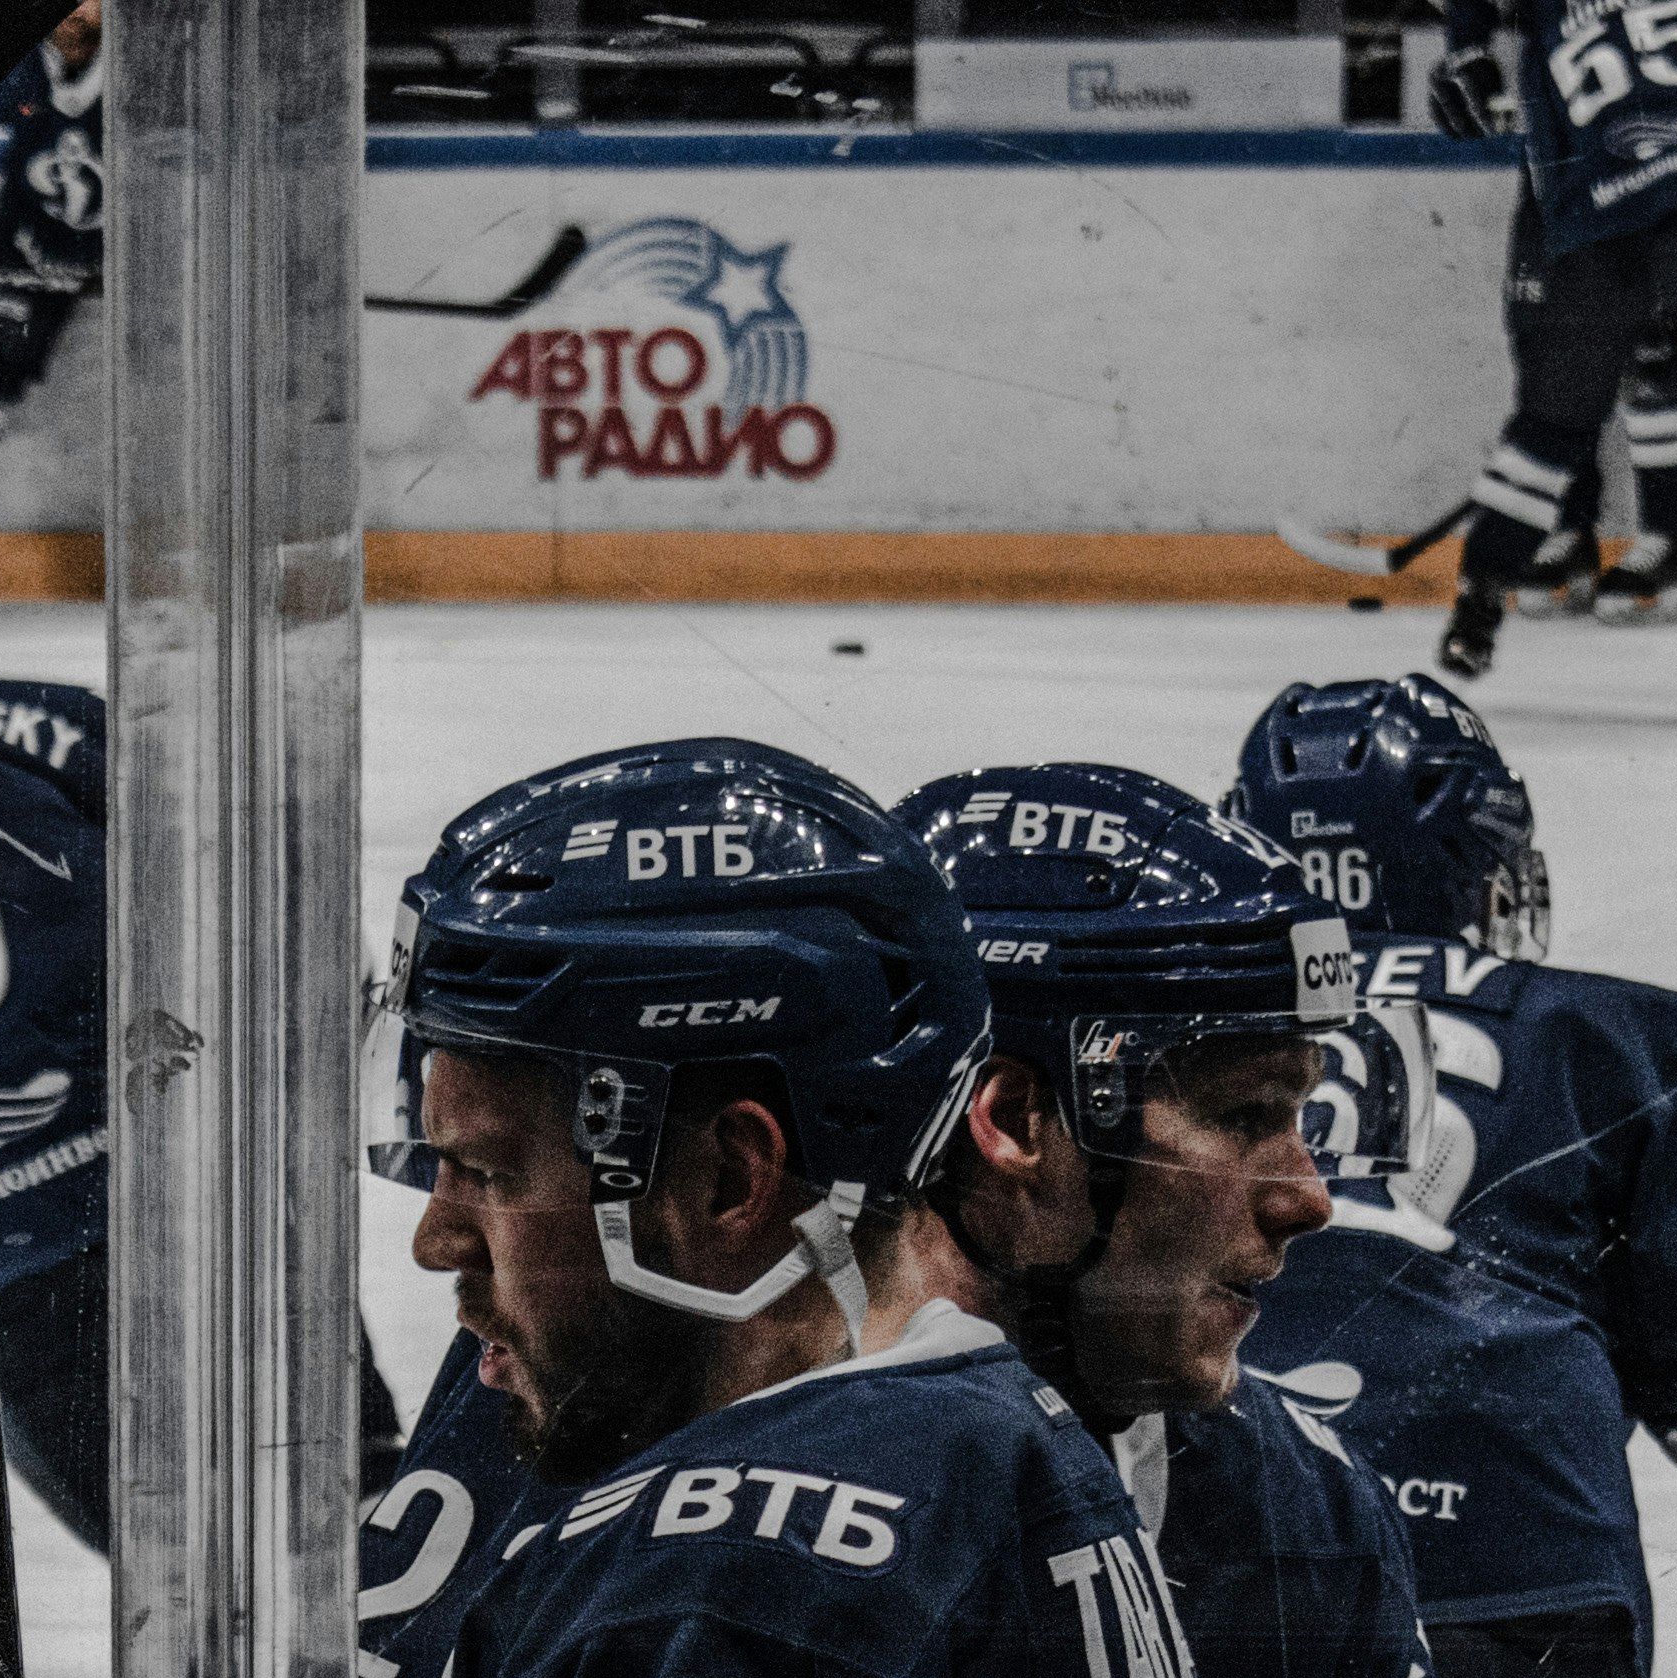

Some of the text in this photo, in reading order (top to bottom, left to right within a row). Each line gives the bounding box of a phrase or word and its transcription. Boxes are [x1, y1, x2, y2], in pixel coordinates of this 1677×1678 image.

[473, 327, 707, 401] АВТО
[538, 403, 836, 480] РАДИО
[626, 824, 756, 882] ВТБ
[1008, 802, 1129, 857] ВТБ
[637, 997, 784, 1029] CCM
[649, 1466, 912, 1568] ВТБ
